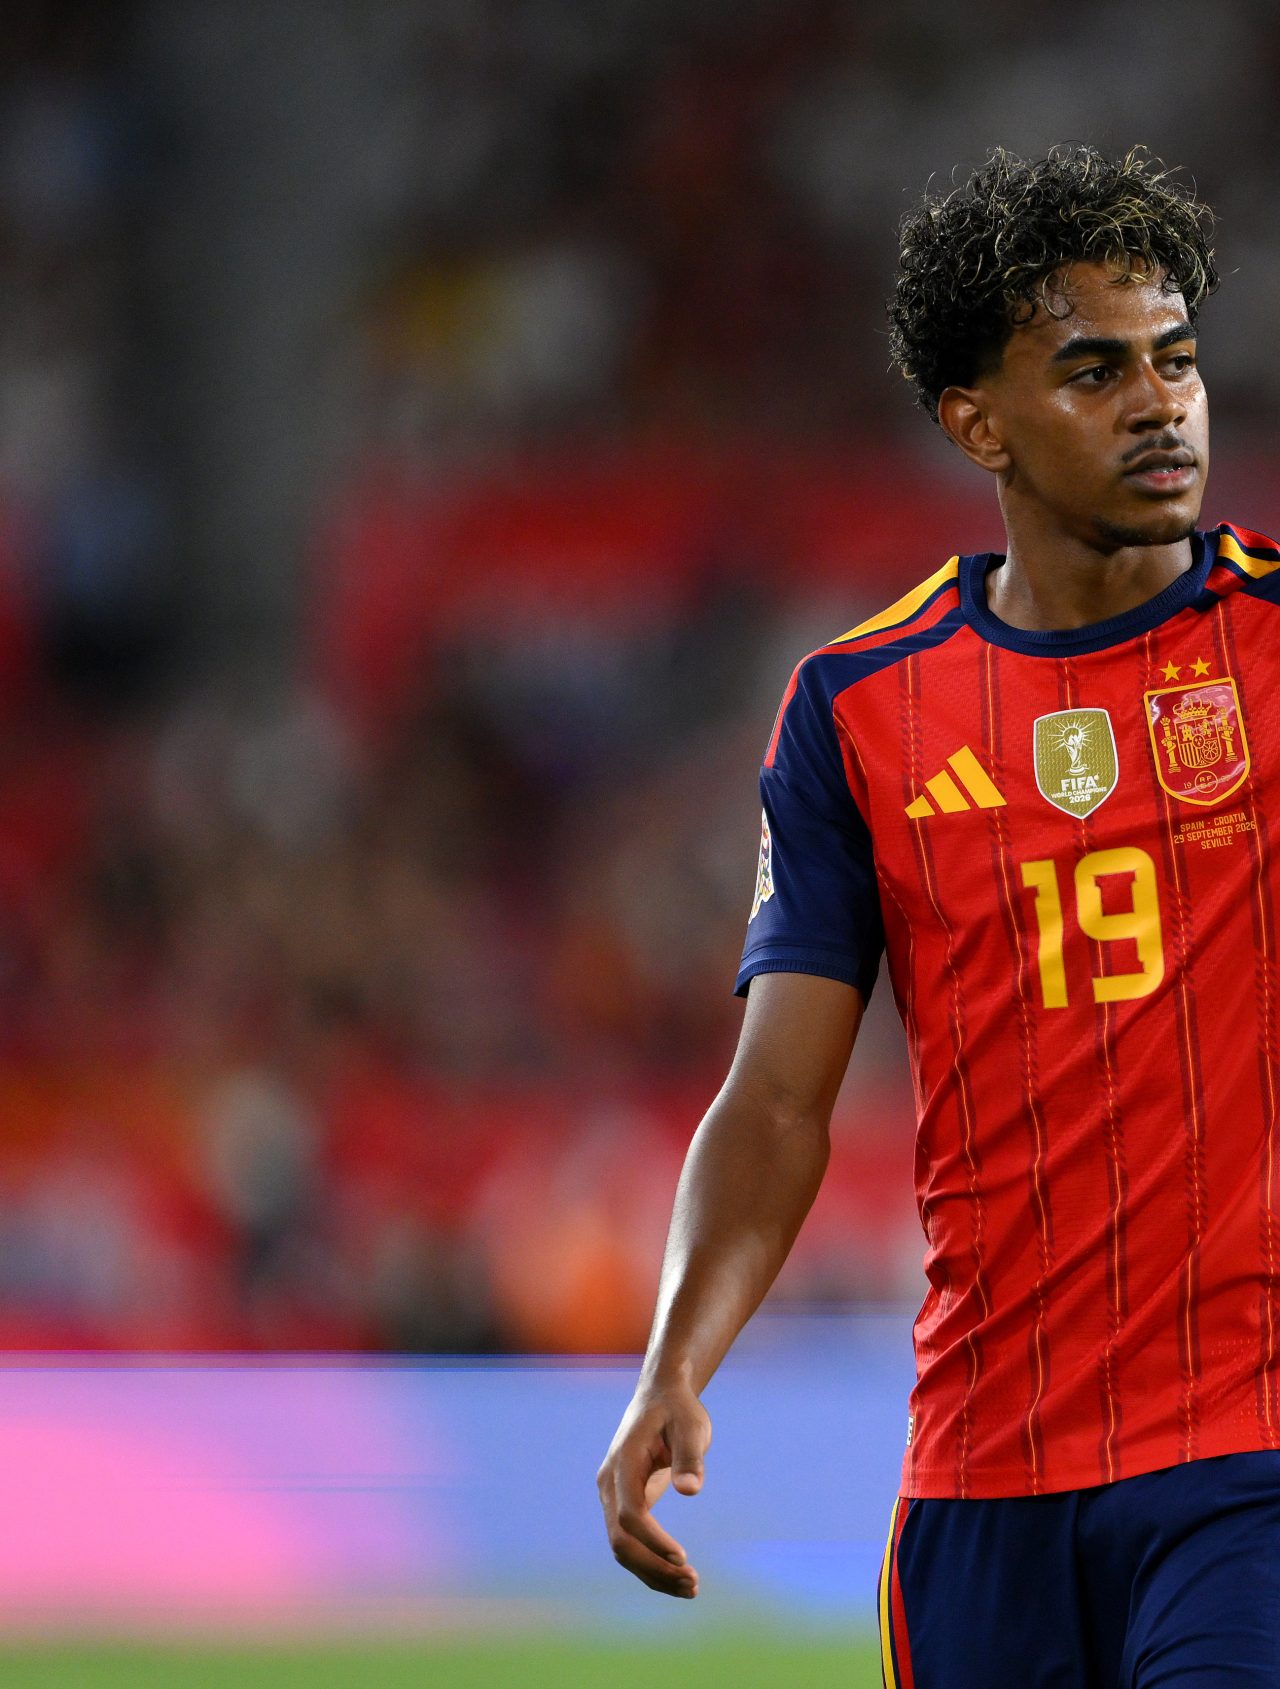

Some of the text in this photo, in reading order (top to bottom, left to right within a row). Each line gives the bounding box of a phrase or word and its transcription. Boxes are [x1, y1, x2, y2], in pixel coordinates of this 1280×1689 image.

[1061, 775, 1098, 791] FIFA
[1051, 791, 1072, 799] WORLD
[1069, 794, 1091, 804] 2026
[1180, 820, 1205, 833] SPAIN
[1213, 812, 1247, 826] CROATIA
[1173, 820, 1256, 844] 29 SEPTEMBER 2026
[1200, 835, 1233, 850] SEVILLE
[1020, 846, 1165, 1009] 19
